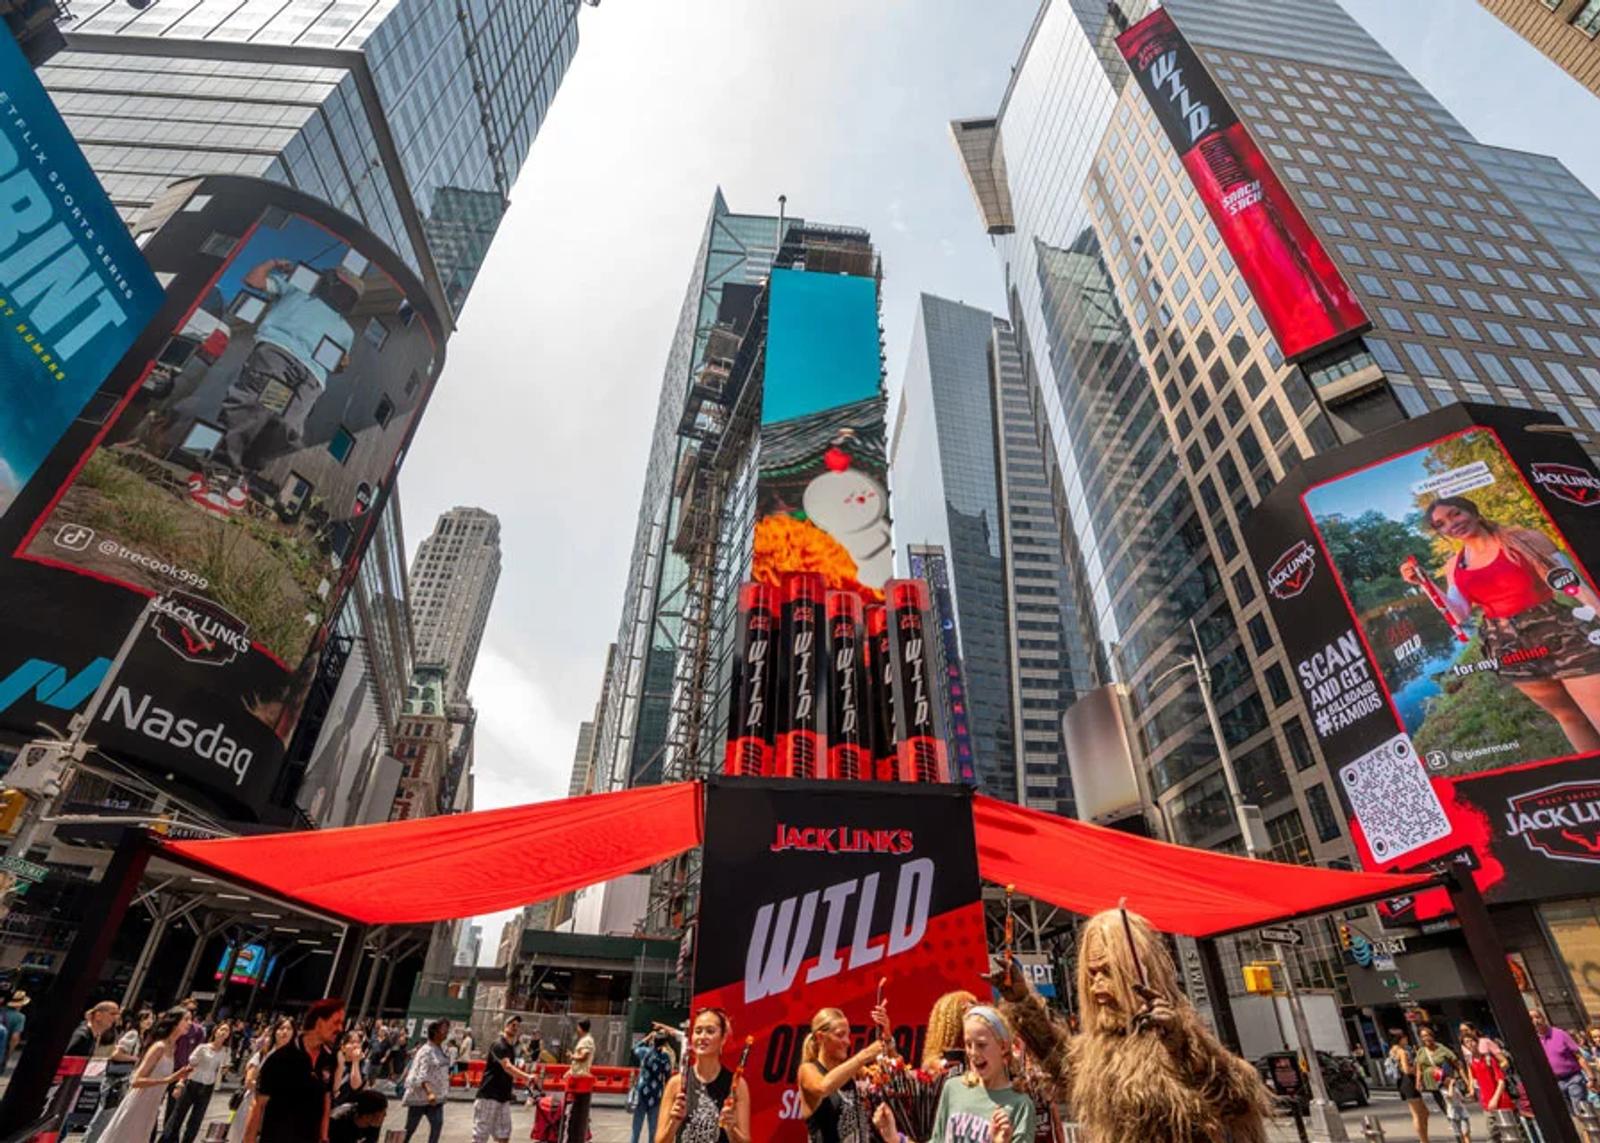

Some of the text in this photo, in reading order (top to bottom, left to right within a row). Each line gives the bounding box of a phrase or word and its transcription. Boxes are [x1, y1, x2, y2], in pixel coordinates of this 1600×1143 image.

[48, 170, 95, 240] SPORTS
[96, 244, 133, 299] SERIES
[16, 323, 66, 381] HUMANS
[98, 540, 208, 590] @trecook999
[152, 596, 201, 630] JACK
[1298, 629, 1362, 689] SCAN
[1311, 676, 1341, 711] AND
[1339, 657, 1369, 690] GET
[1453, 645, 1549, 677] for my online
[102, 686, 253, 786] Nasdaq
[771, 823, 838, 852] JACK
[1505, 799, 1600, 837] JACK LI
[744, 857, 934, 1004] WILD
